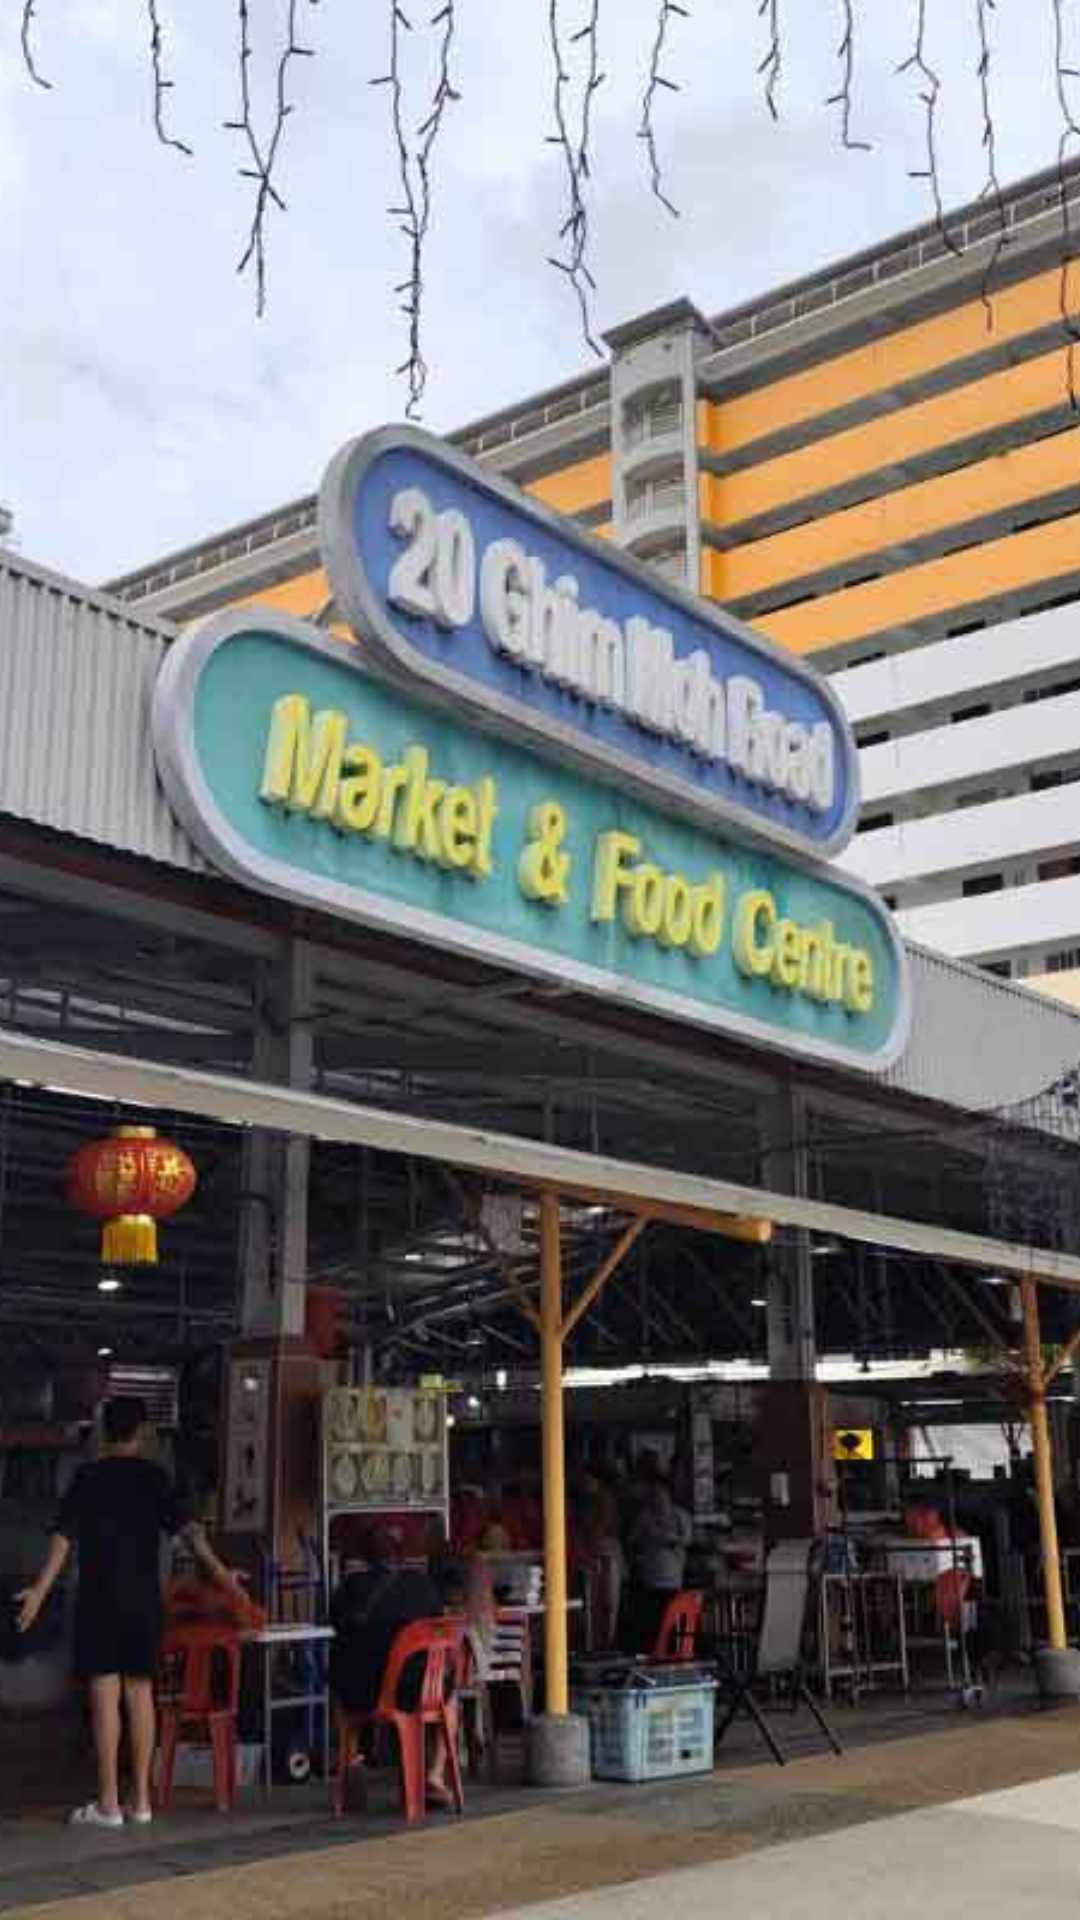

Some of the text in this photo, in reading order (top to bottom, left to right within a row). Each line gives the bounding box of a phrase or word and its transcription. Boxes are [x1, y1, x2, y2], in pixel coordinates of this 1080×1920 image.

[388, 488, 474, 629] 20
[480, 537, 625, 706] Ghim
[726, 675, 834, 809] Road
[260, 695, 872, 1011] Market & Food Centre
